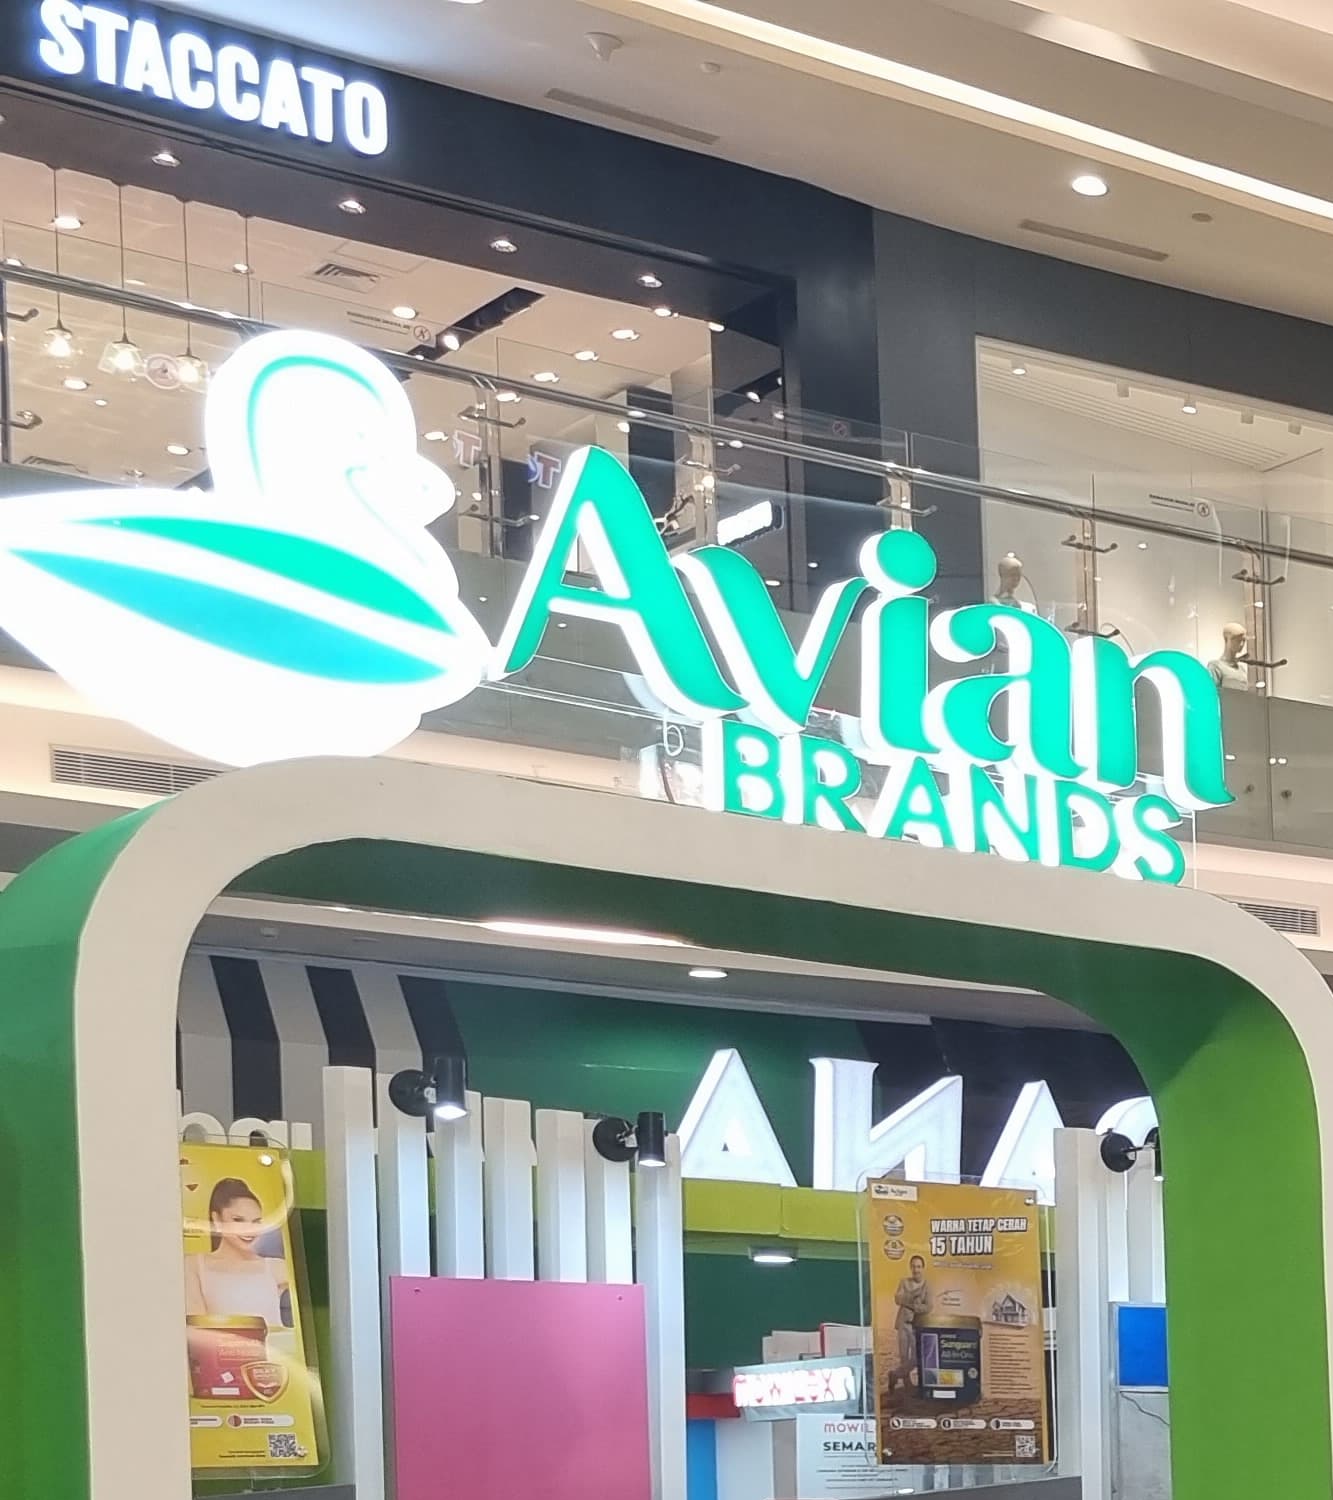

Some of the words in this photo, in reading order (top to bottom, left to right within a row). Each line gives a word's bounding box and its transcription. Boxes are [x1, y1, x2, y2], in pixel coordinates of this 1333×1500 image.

[38, 0, 389, 156] STACCATO
[490, 443, 1237, 810] Avian
[702, 716, 1187, 887] BRANDS
[930, 1237, 946, 1256] 15
[950, 1235, 993, 1256] TAHUN
[931, 1219, 965, 1233] WARNA
[968, 1218, 995, 1232] TETAP
[997, 1217, 1028, 1232] CERAH
[823, 1440, 877, 1452] SEMAR
